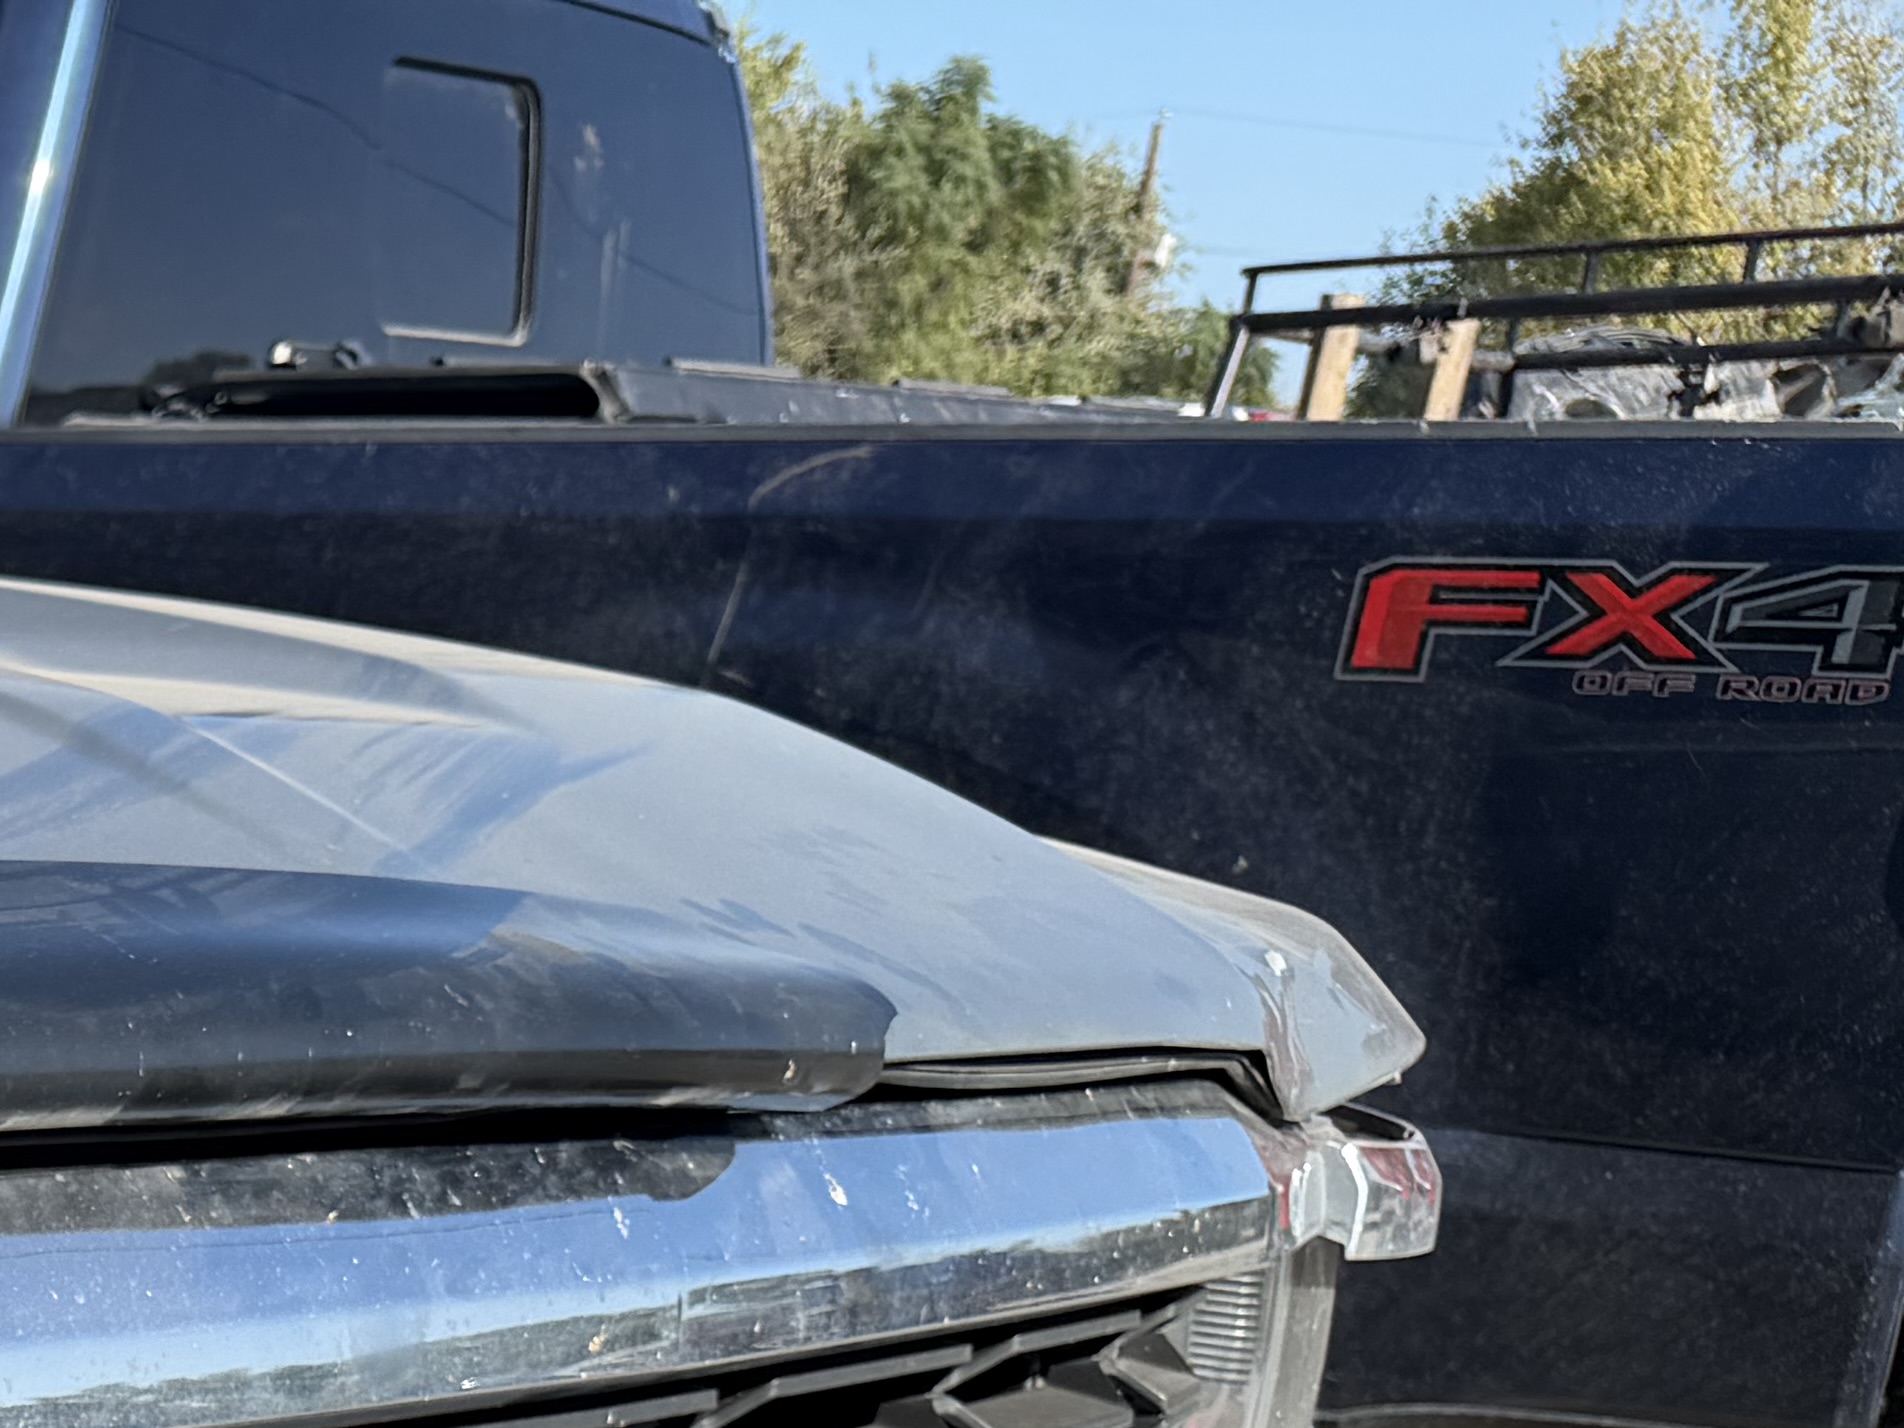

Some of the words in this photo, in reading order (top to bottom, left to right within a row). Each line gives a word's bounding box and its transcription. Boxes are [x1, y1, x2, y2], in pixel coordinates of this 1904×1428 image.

[1333, 556, 1904, 682] FX4
[1571, 670, 1697, 698] OFF
[1715, 675, 1890, 706] ROAD
